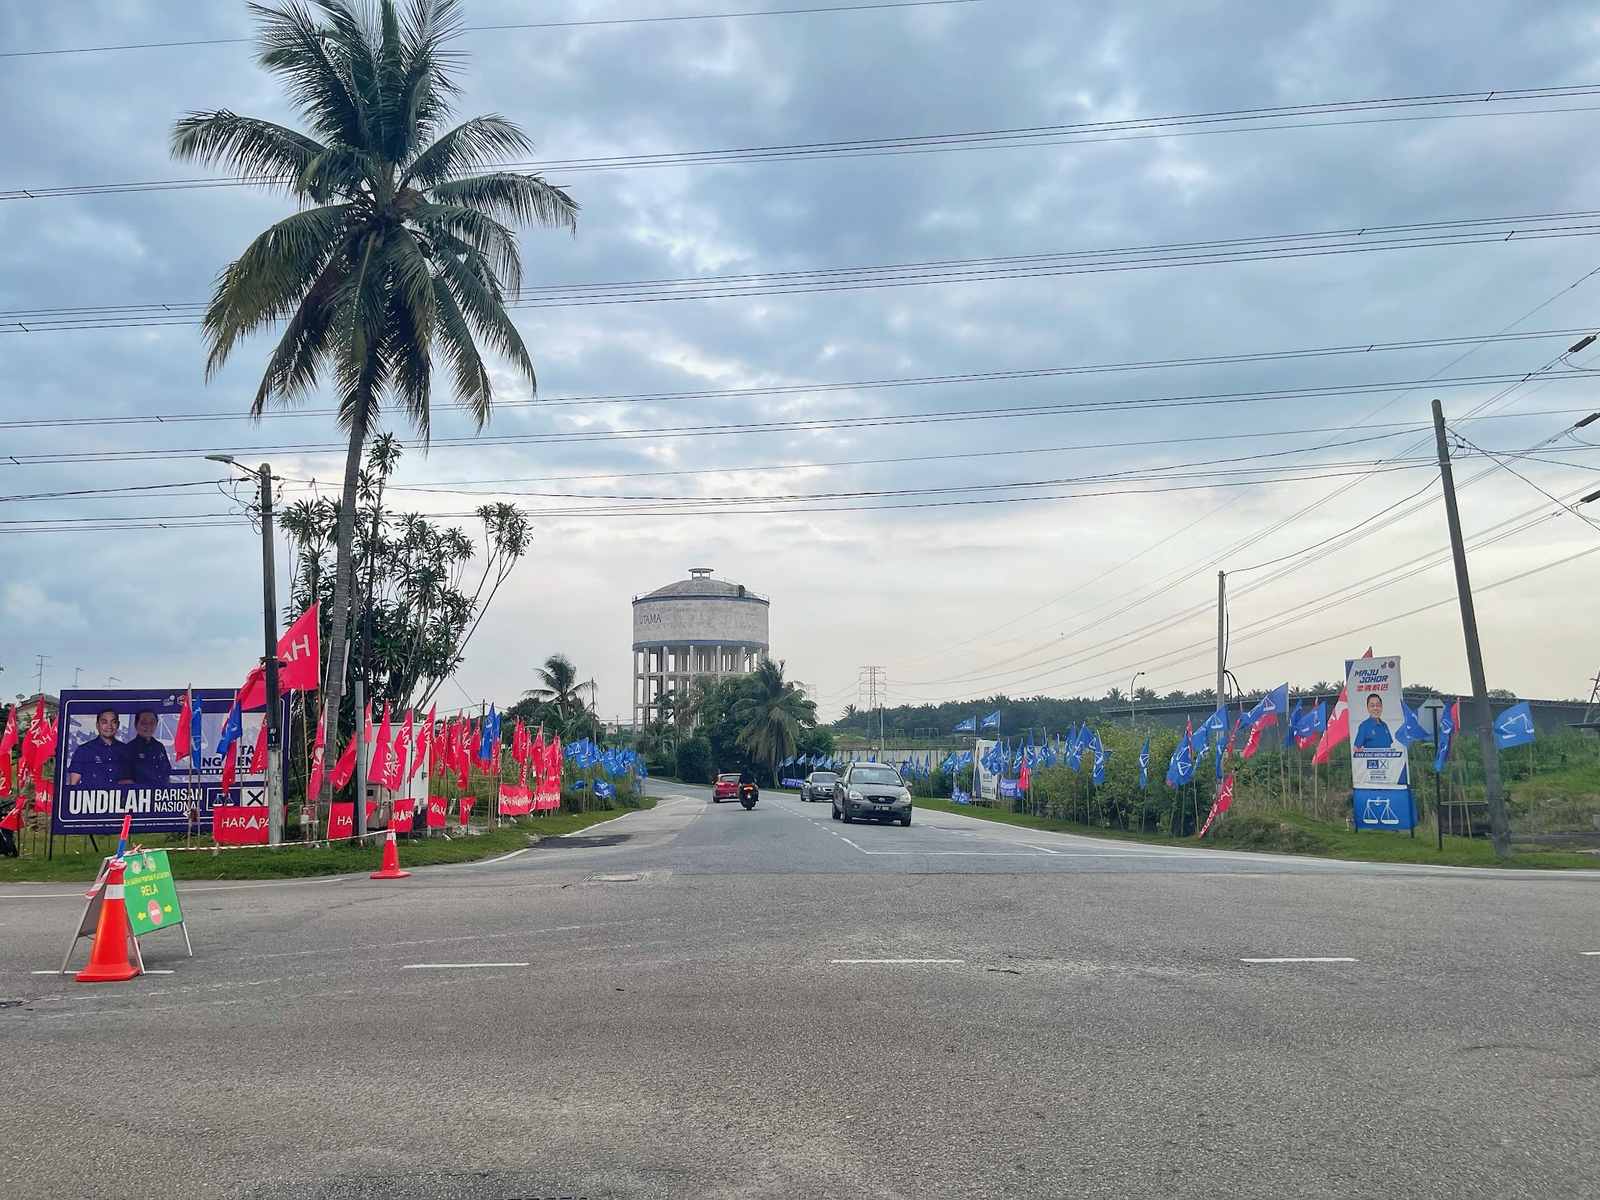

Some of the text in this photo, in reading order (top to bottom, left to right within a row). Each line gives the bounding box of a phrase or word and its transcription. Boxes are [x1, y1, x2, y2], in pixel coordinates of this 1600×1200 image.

[154, 788, 203, 801] BARISAN
[69, 789, 151, 815] UNDILAH
[153, 799, 202, 812] NASIONAL
